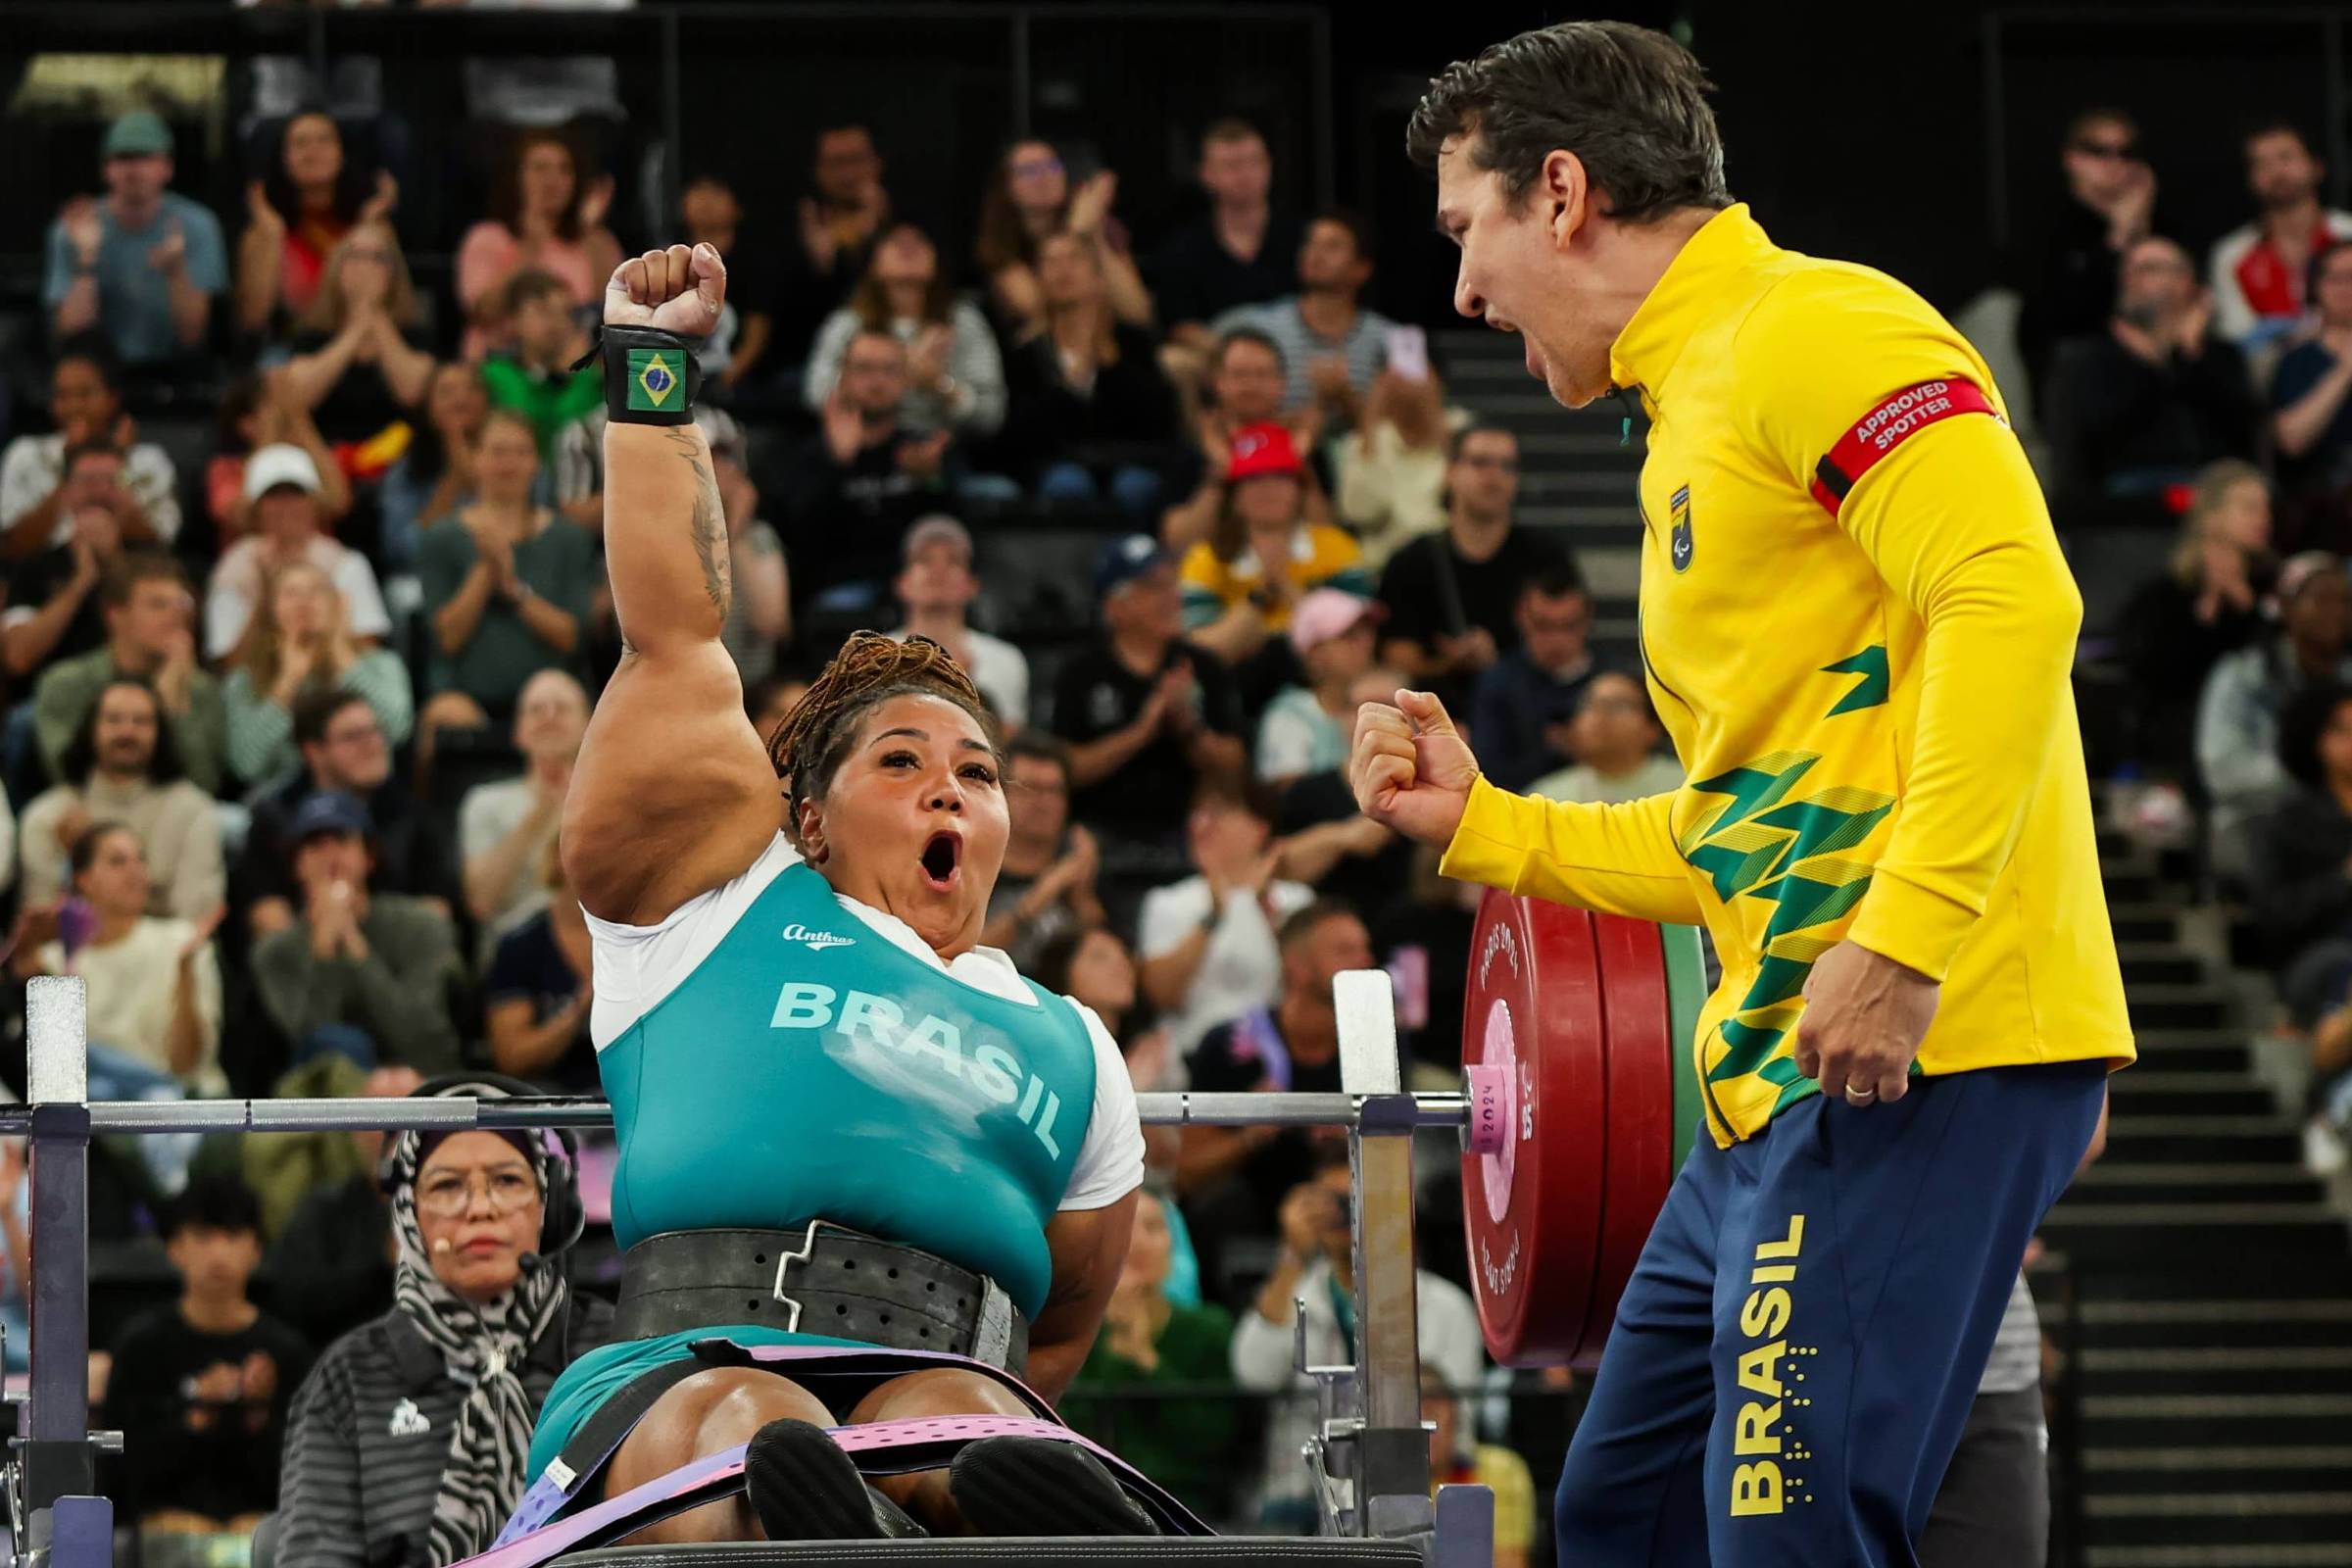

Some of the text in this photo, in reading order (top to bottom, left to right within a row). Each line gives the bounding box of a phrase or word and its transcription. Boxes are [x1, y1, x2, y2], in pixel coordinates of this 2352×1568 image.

[1856, 381, 1948, 443] APPROVED
[1875, 397, 1952, 450] SPOTTER
[1481, 923, 1499, 992] PARIS
[770, 982, 1060, 1161] BRASIL
[1482, 1086, 1494, 1132] 2024
[1730, 1214, 1805, 1517] BRASIL
